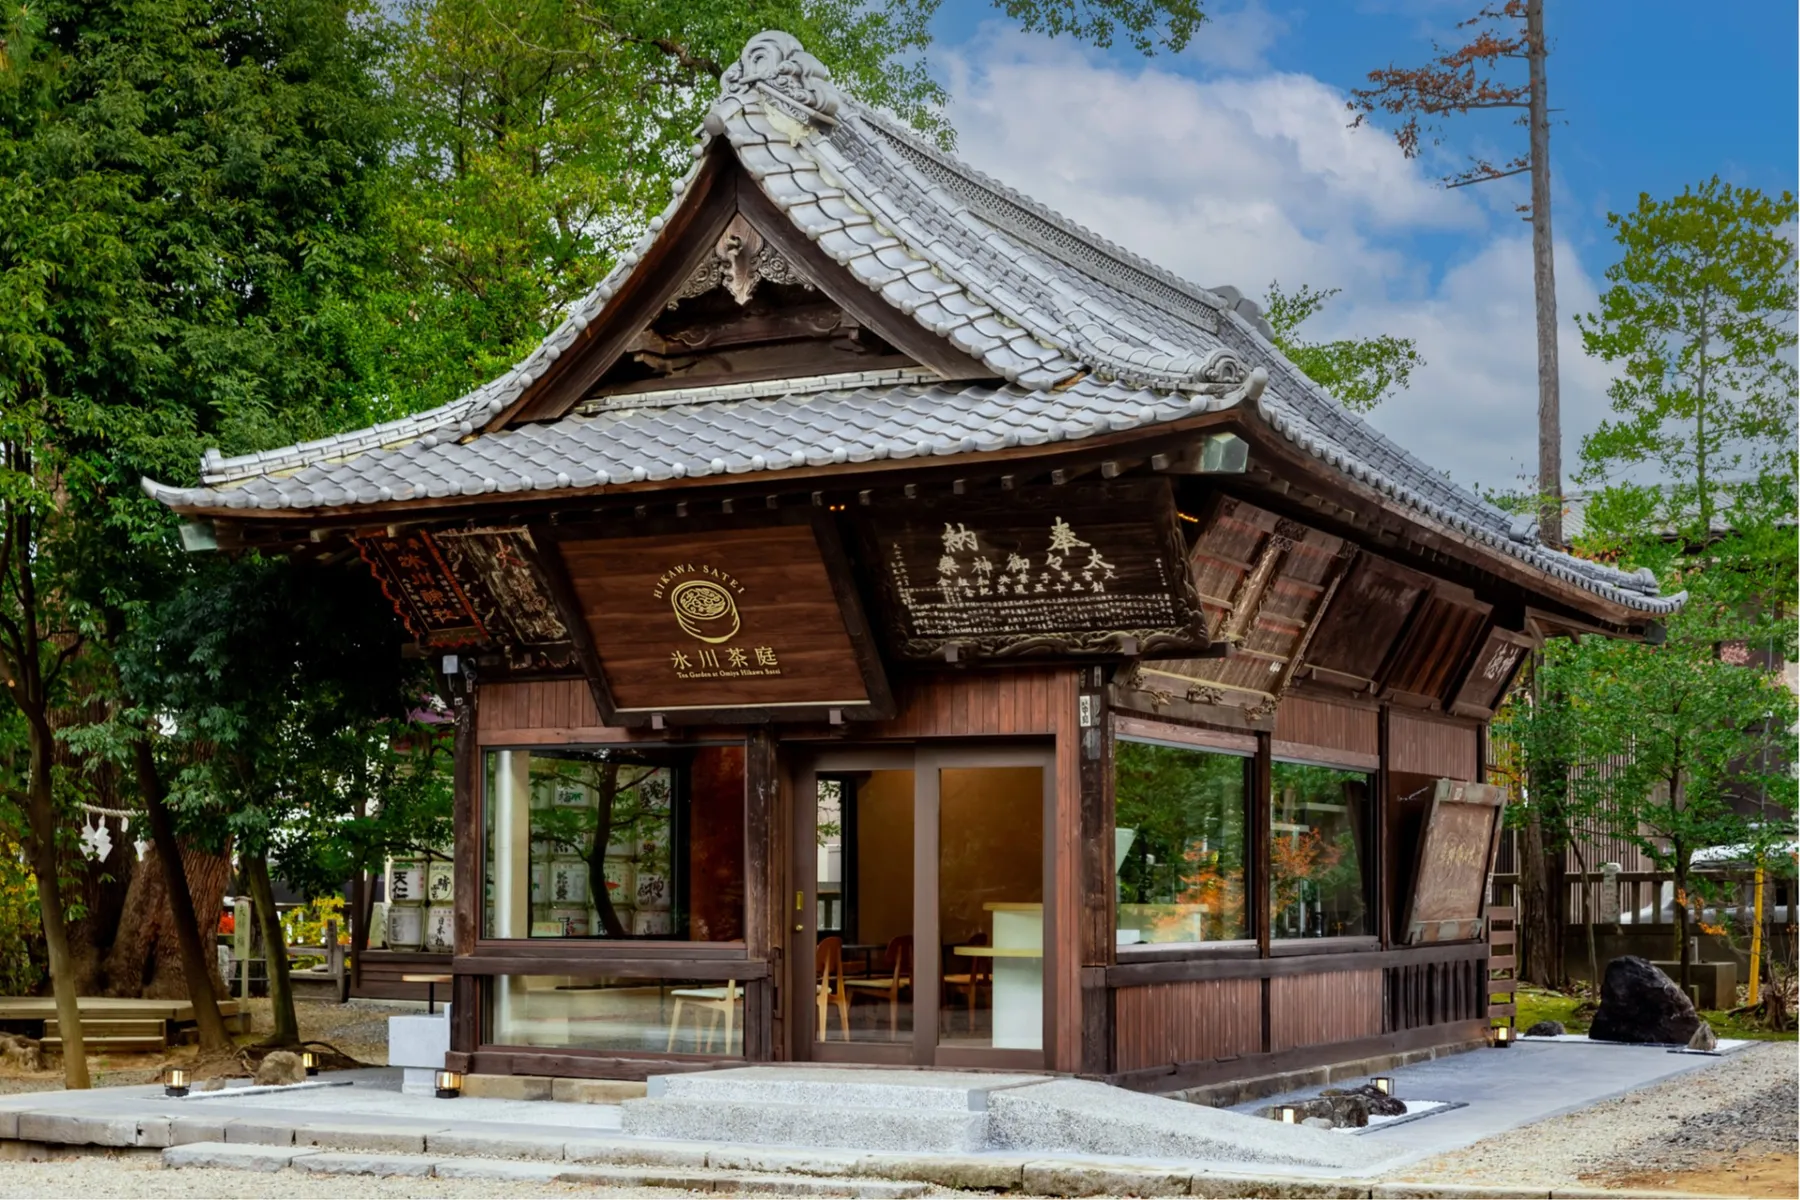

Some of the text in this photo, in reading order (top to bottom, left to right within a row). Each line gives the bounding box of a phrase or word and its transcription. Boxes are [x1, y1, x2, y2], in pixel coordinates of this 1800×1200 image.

[941, 516, 1091, 556] 奉納
[653, 563, 745, 599] HIKAWA SATEI
[670, 646, 778, 670] 氷川茶庭
[677, 671, 689, 679] Tea
[720, 670, 739, 678] Omiya
